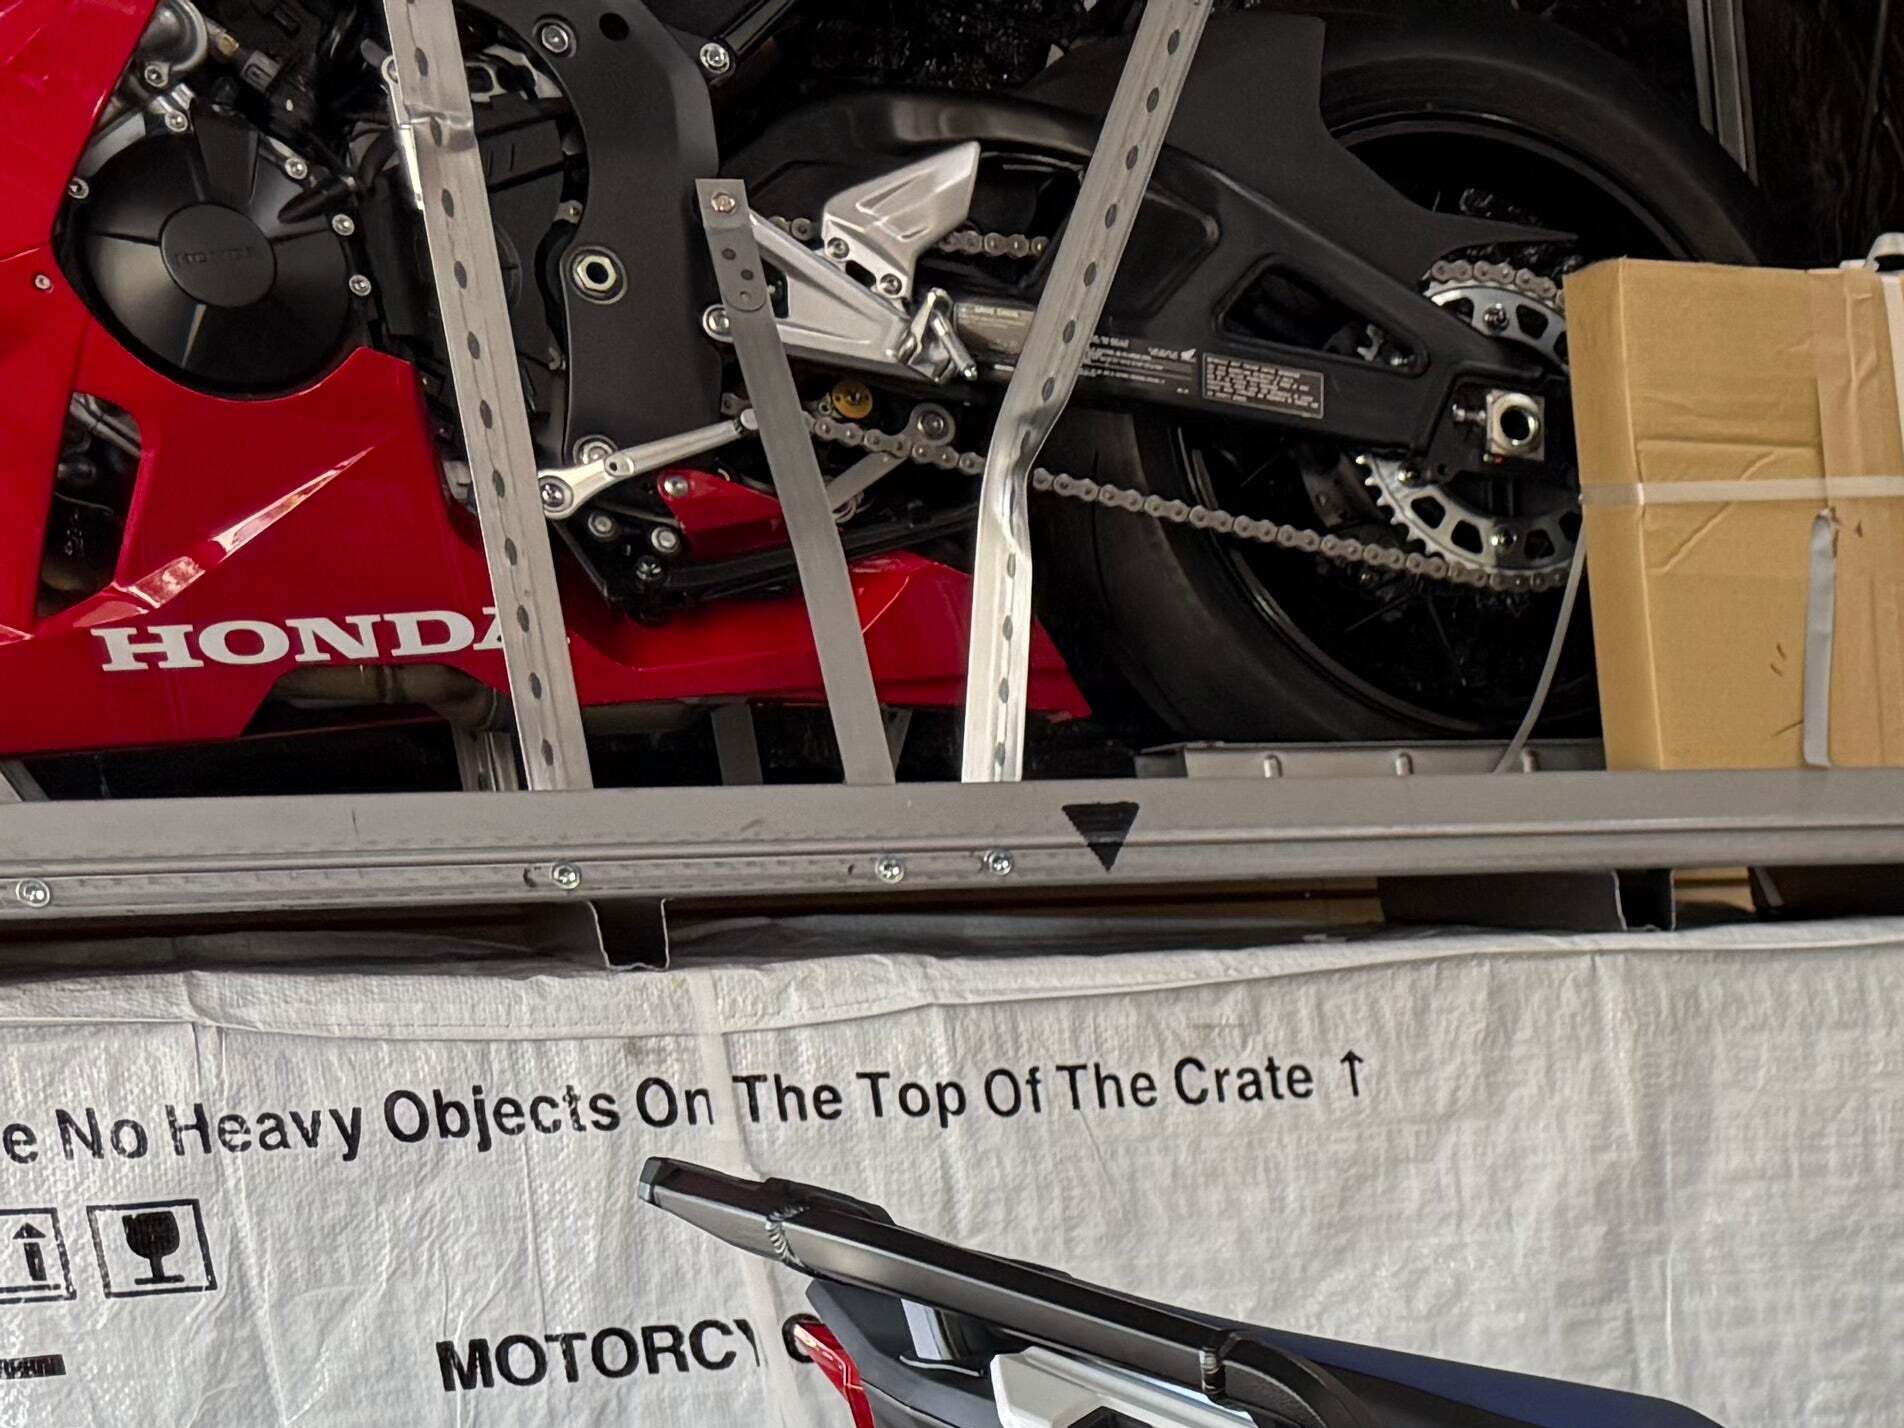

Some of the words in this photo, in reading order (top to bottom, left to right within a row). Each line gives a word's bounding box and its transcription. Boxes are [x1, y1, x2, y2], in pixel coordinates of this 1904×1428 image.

[56, 1107, 150, 1162] No
[168, 1095, 364, 1161] Heavy
[382, 1083, 622, 1152] Objects
[634, 1076, 714, 1128] On
[732, 1070, 843, 1122] The
[856, 1068, 967, 1127] Top
[985, 1066, 1042, 1118] Of
[1055, 1060, 1158, 1112] The
[1173, 1055, 1315, 1106] Crate
